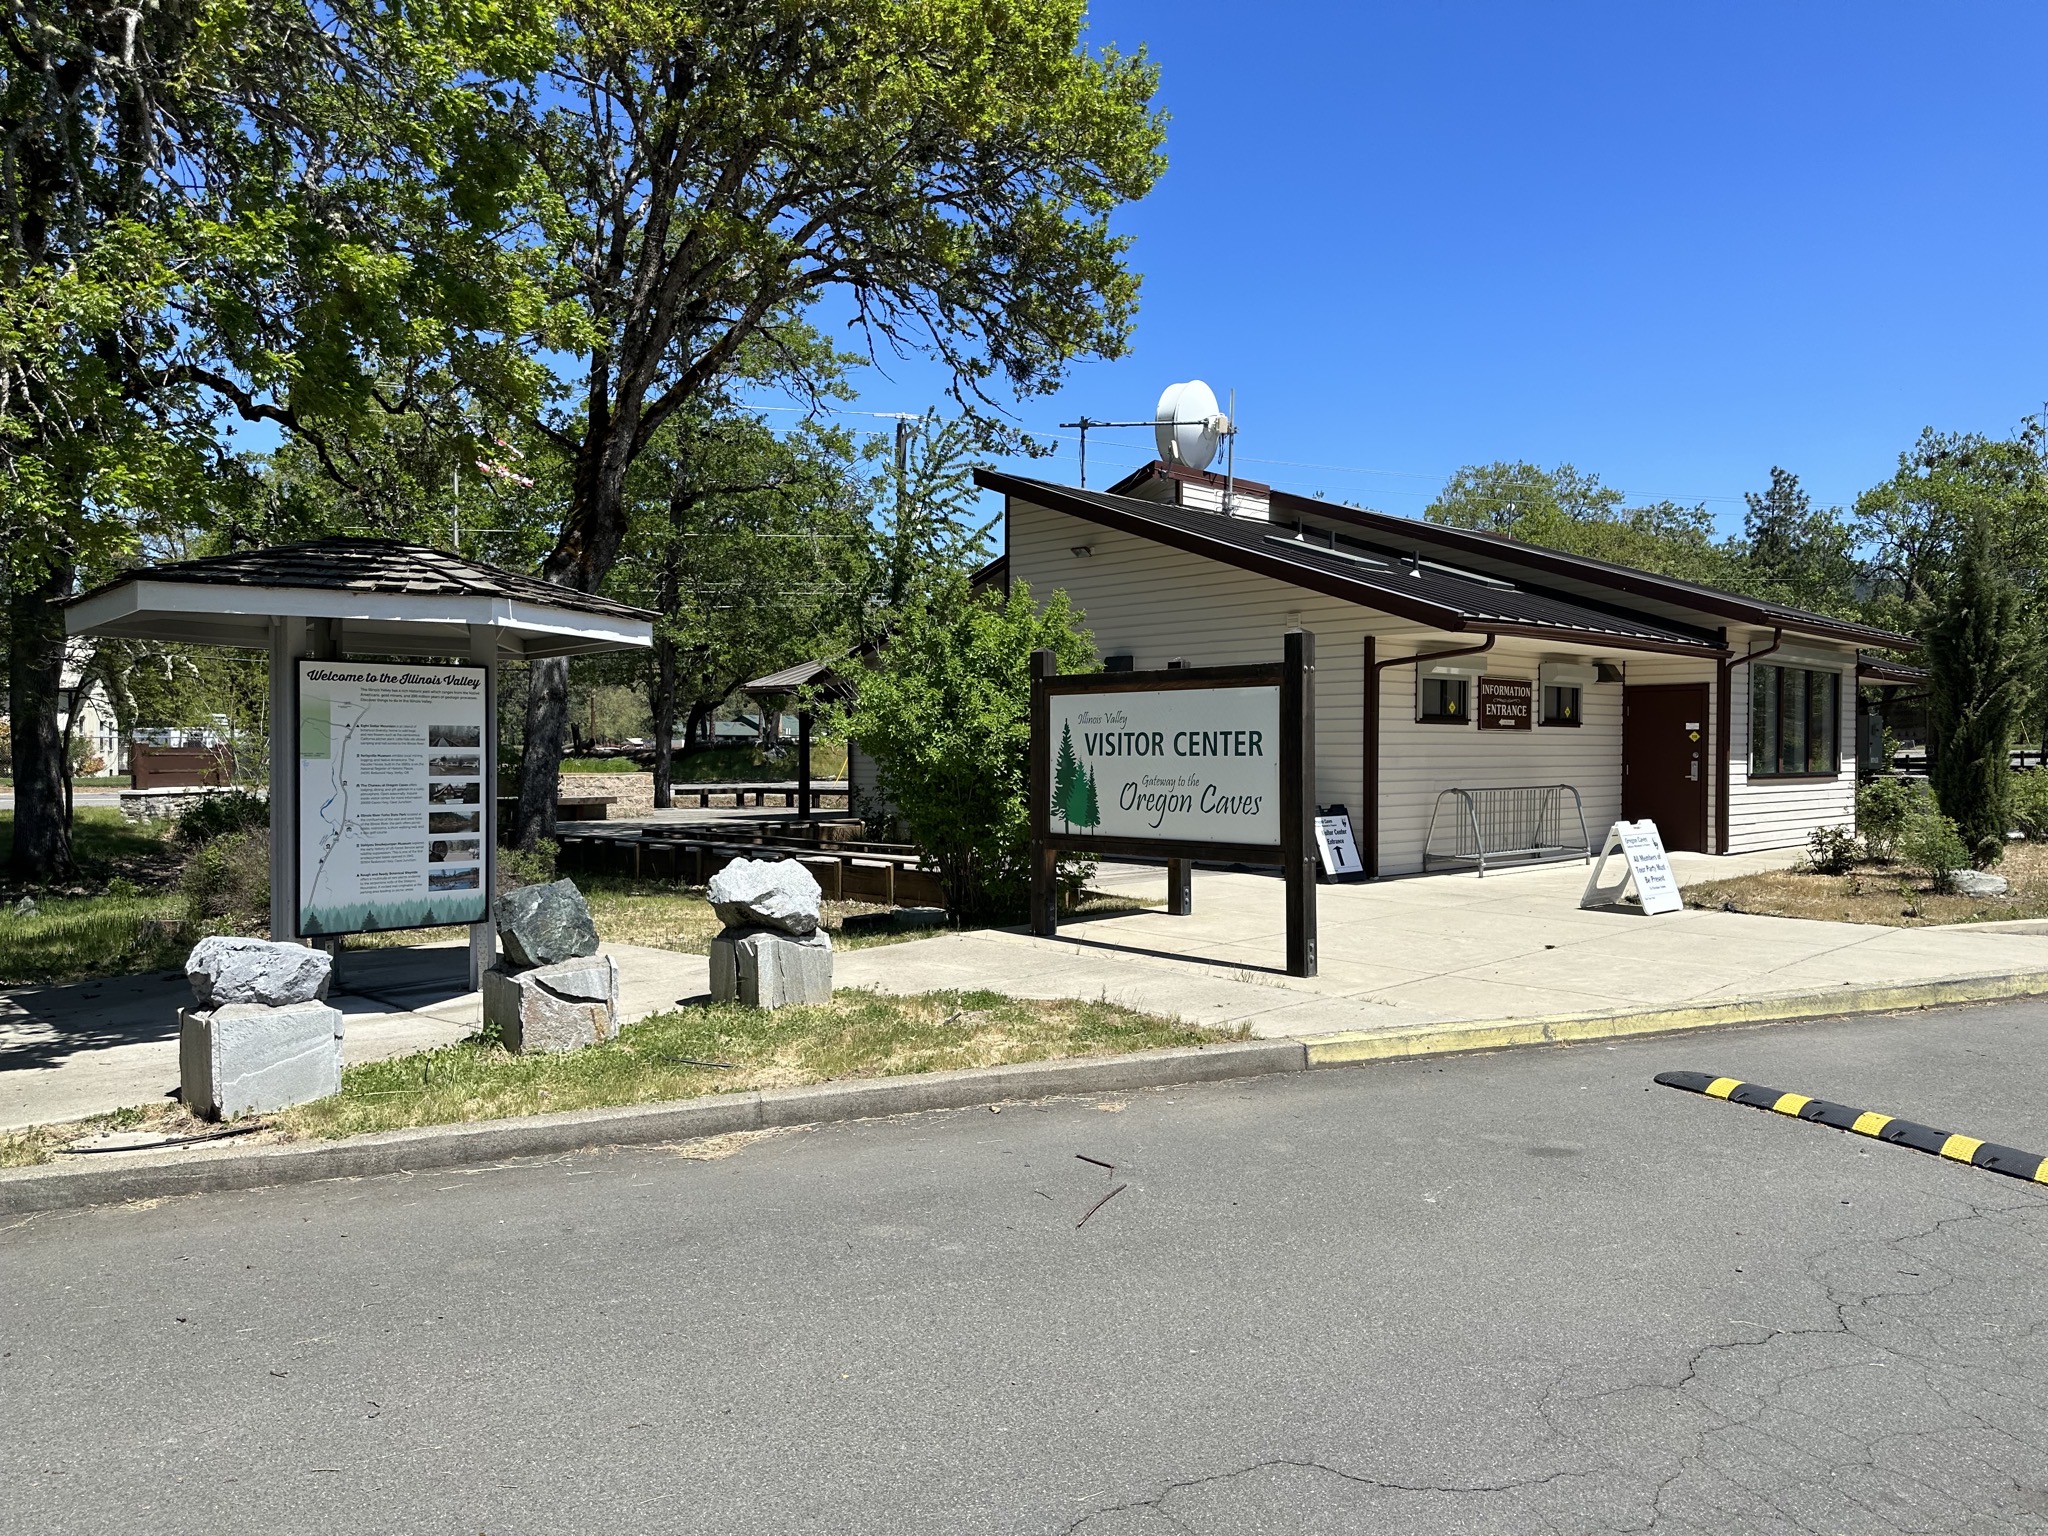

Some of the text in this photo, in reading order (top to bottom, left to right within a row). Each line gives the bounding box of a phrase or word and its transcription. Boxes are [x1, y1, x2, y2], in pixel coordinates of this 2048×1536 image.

[307, 669, 481, 690] Welcome to the Illinois Valley
[1482, 684, 1531, 697] INFORMATION
[1078, 710, 1128, 730] Illinois Valley
[1486, 703, 1528, 717] ENTRANCE
[1084, 730, 1264, 757] VISITOR CENTER
[1141, 773, 1200, 793] Gateway to the
[1119, 781, 1263, 828] Oregon Caves
